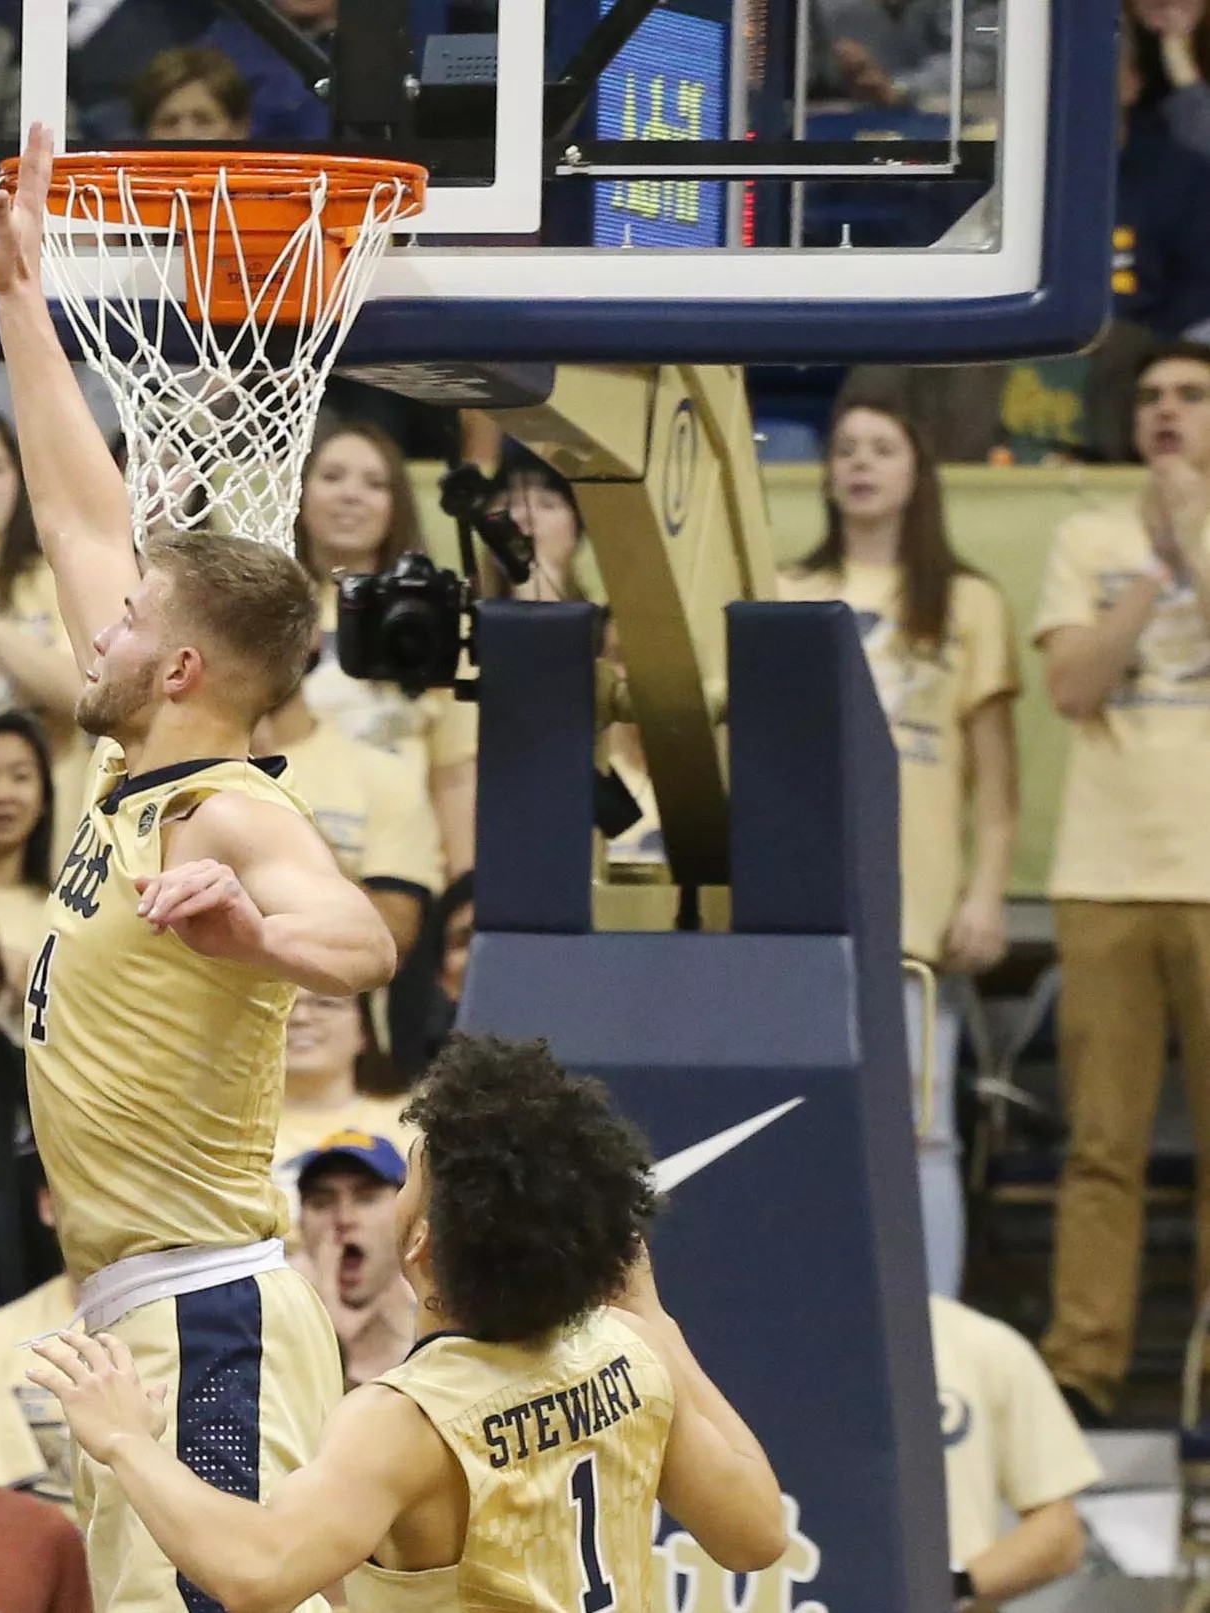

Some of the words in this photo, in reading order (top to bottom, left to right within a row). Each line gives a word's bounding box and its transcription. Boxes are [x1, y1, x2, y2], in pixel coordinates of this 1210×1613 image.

[26, 928, 59, 1045] 4
[483, 1355, 641, 1468] STEWART
[568, 1450, 616, 1613] 1
